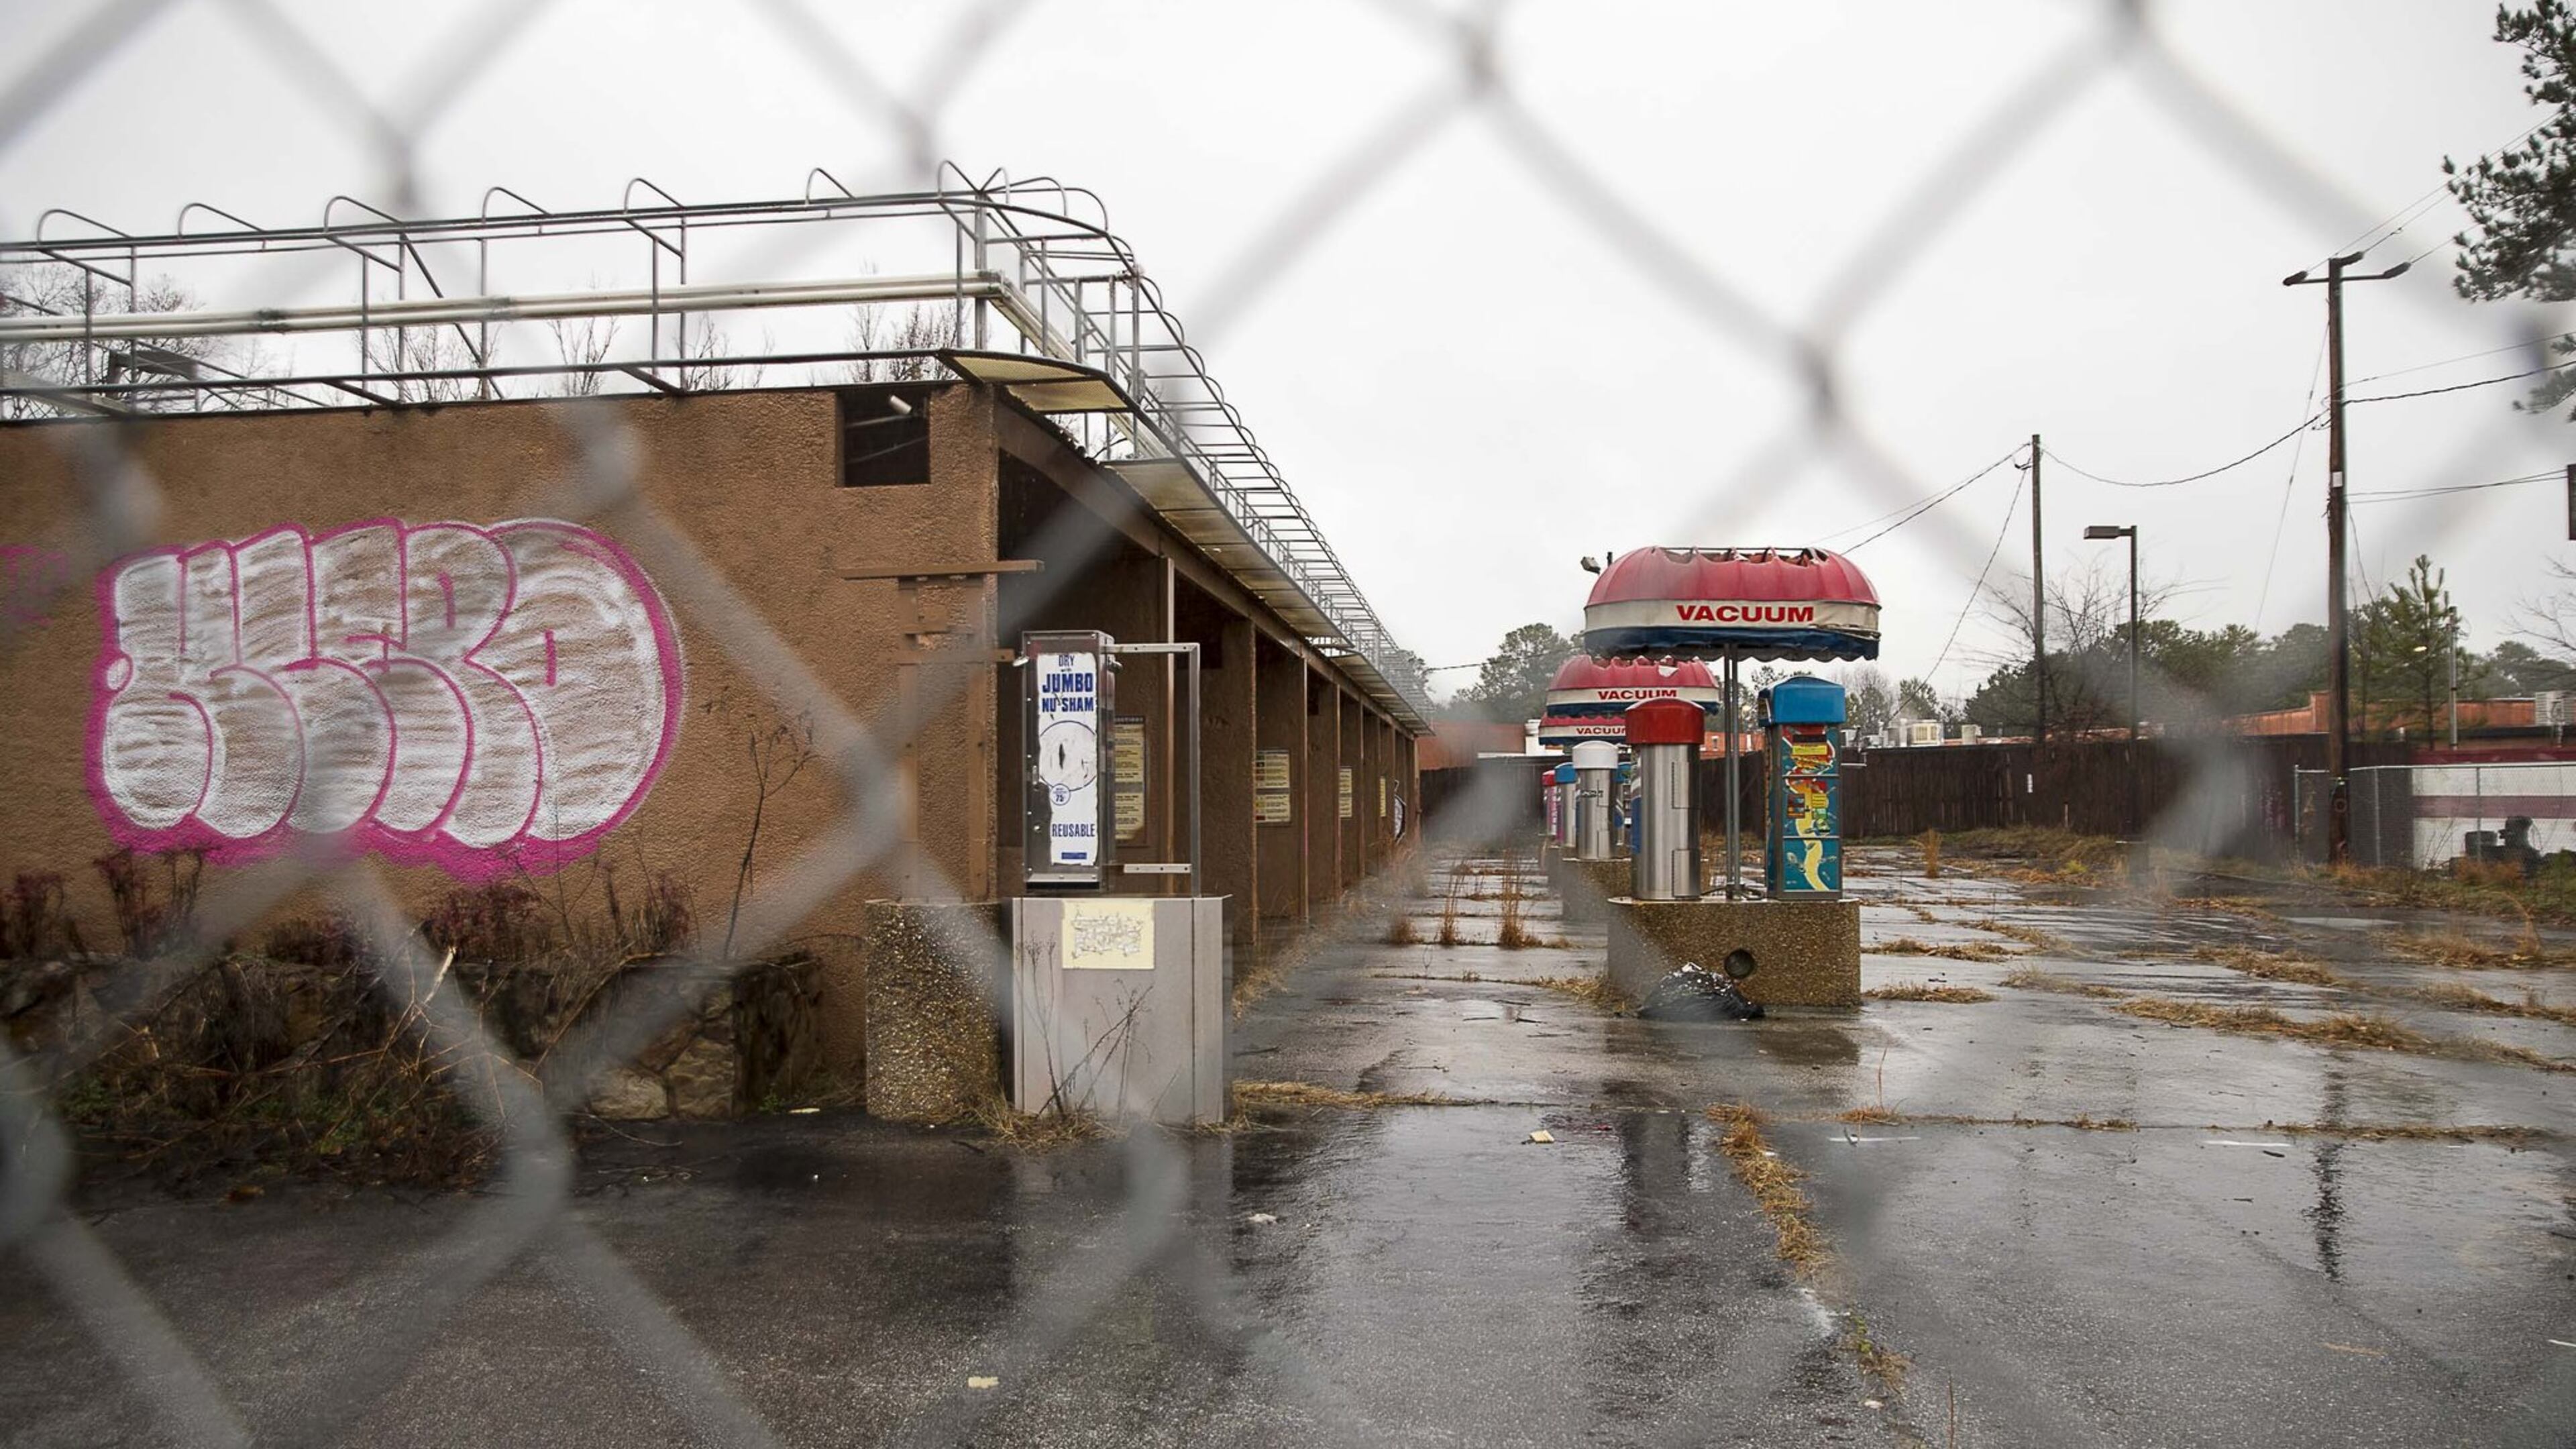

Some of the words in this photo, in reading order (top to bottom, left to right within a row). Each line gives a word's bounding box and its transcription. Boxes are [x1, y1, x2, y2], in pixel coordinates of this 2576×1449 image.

[1676, 604, 1814, 623] VACUUM
[1059, 655, 1075, 666] DRY
[1042, 673, 1093, 693] JUMBO
[1598, 689, 1677, 700] VACUUM
[1061, 696, 1094, 712] SHAM
[1052, 823, 1095, 837] REUSABLE
